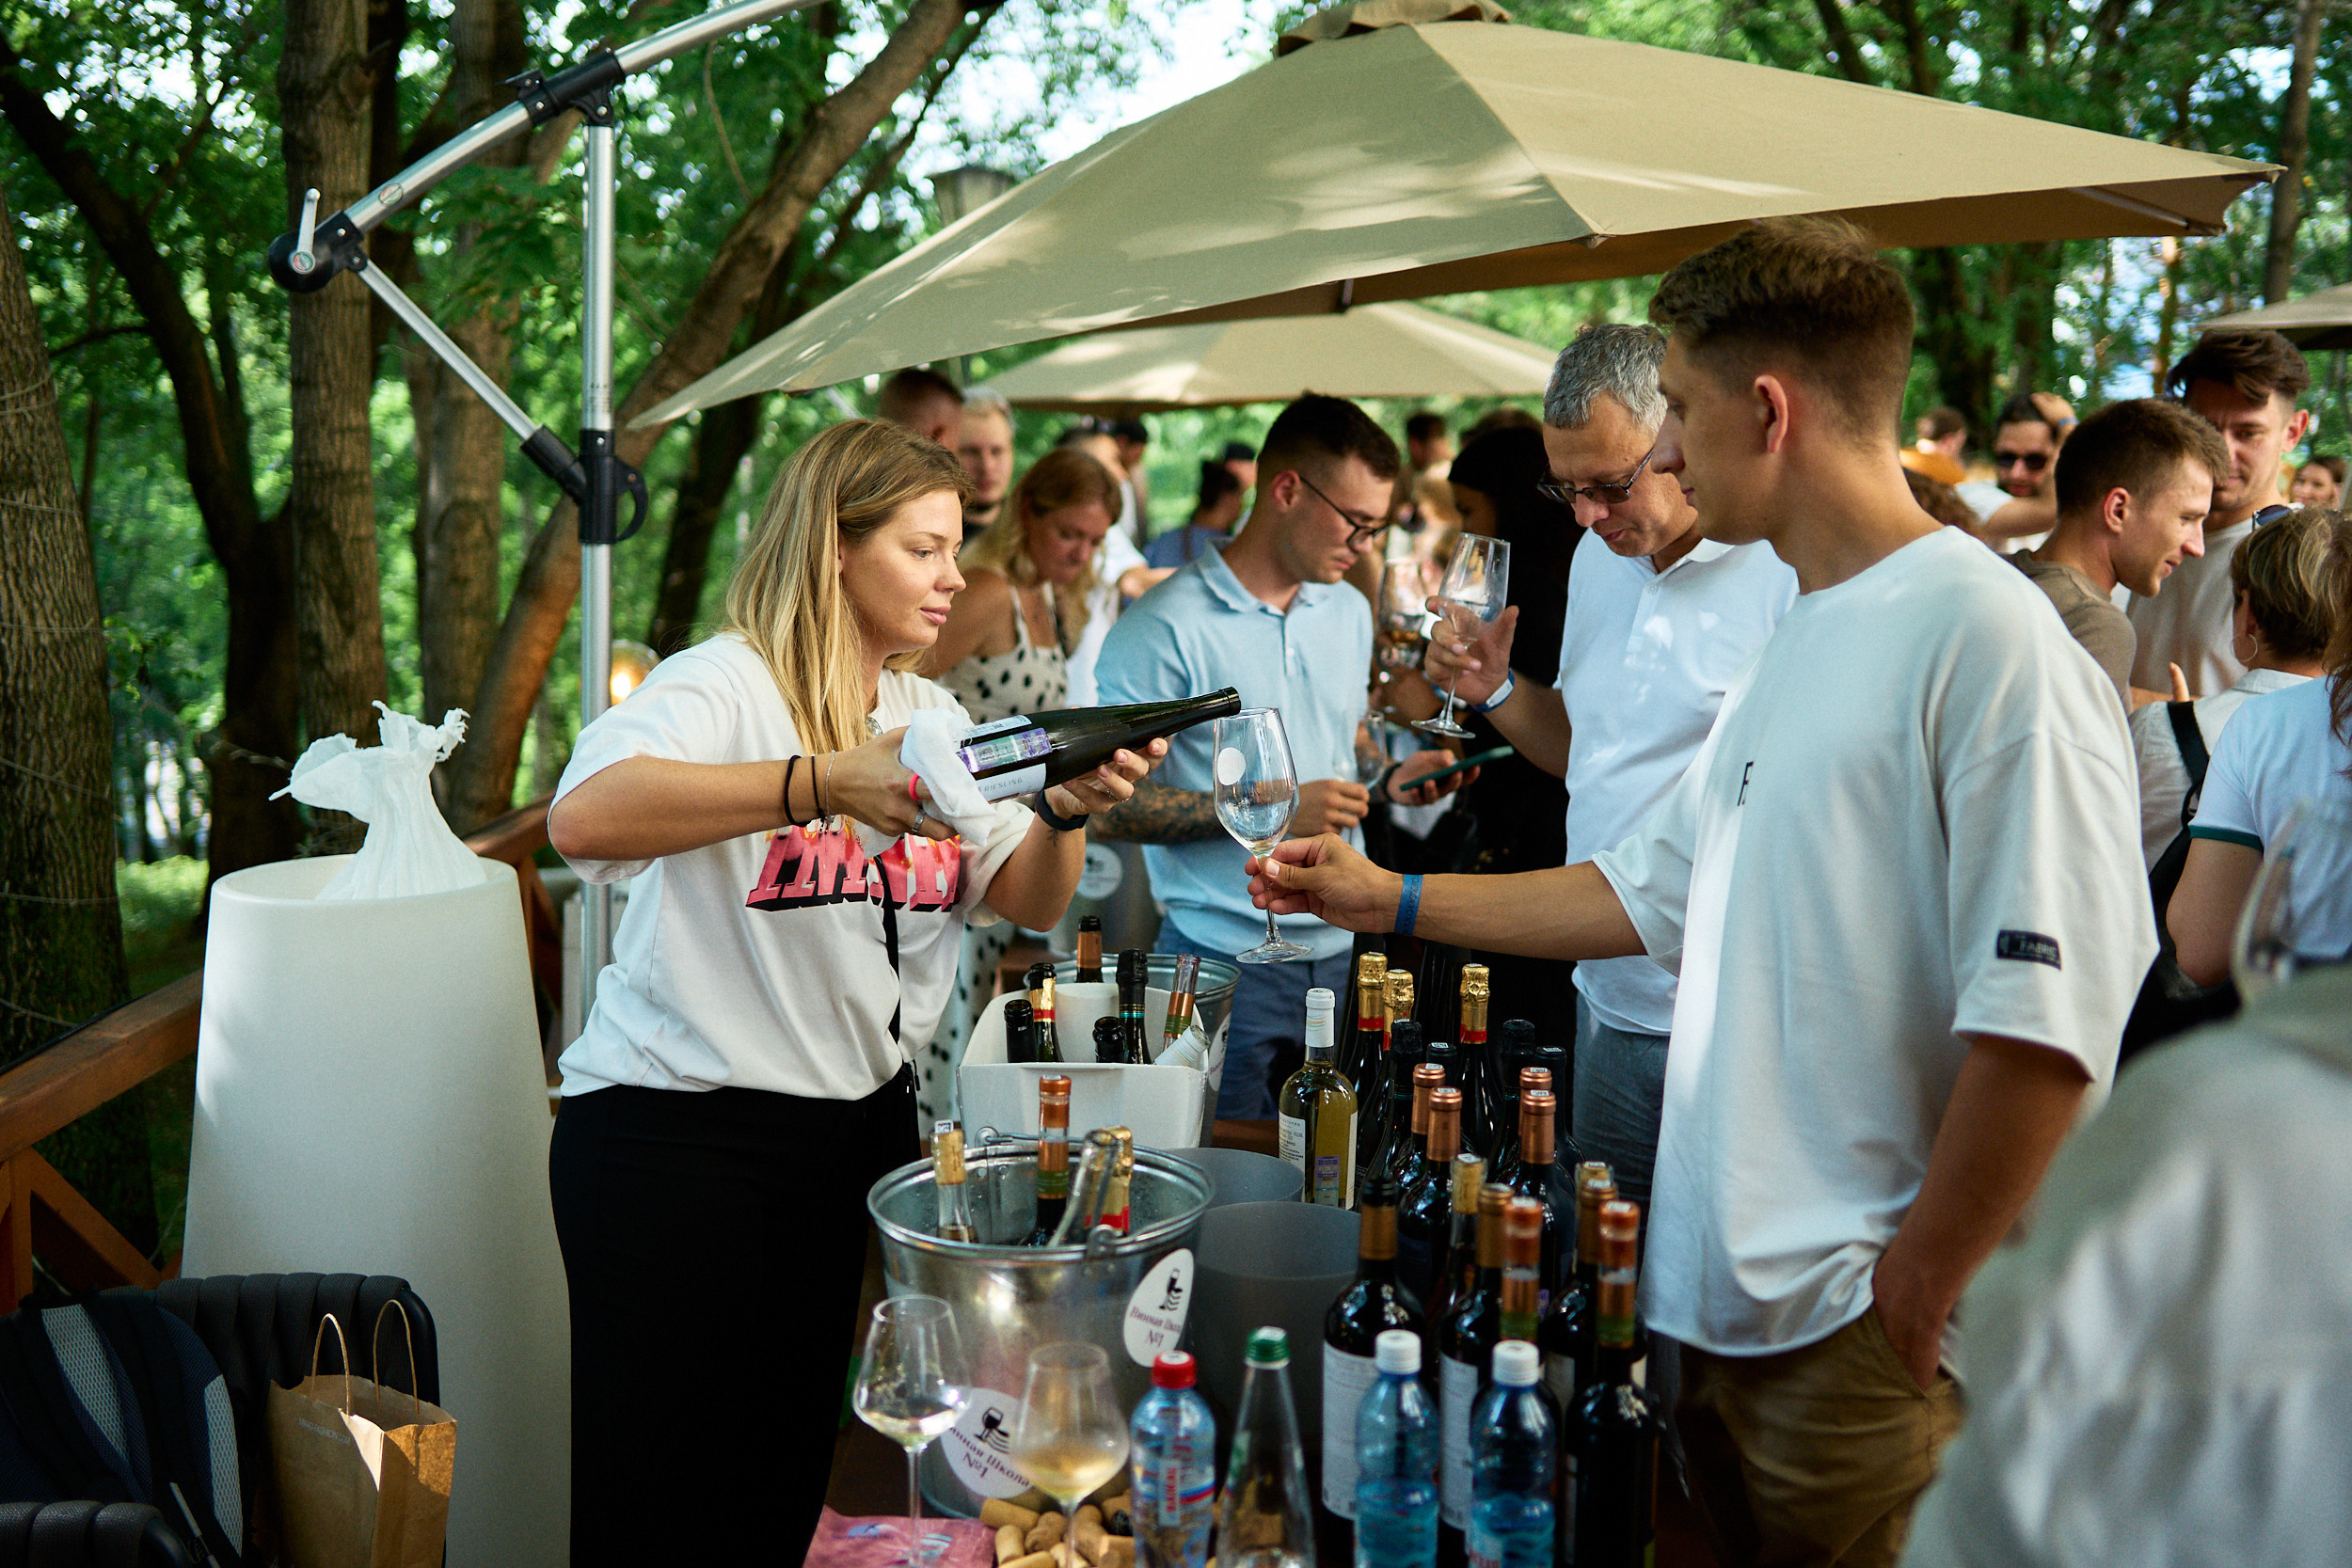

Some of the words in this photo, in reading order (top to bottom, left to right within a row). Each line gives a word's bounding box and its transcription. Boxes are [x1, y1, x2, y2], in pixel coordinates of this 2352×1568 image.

[983, 777, 1024, 793] RIESLING
[949, 1426, 985, 1458] инная
[986, 1454, 1031, 1487] Школа
[962, 1452, 989, 1479] №1
